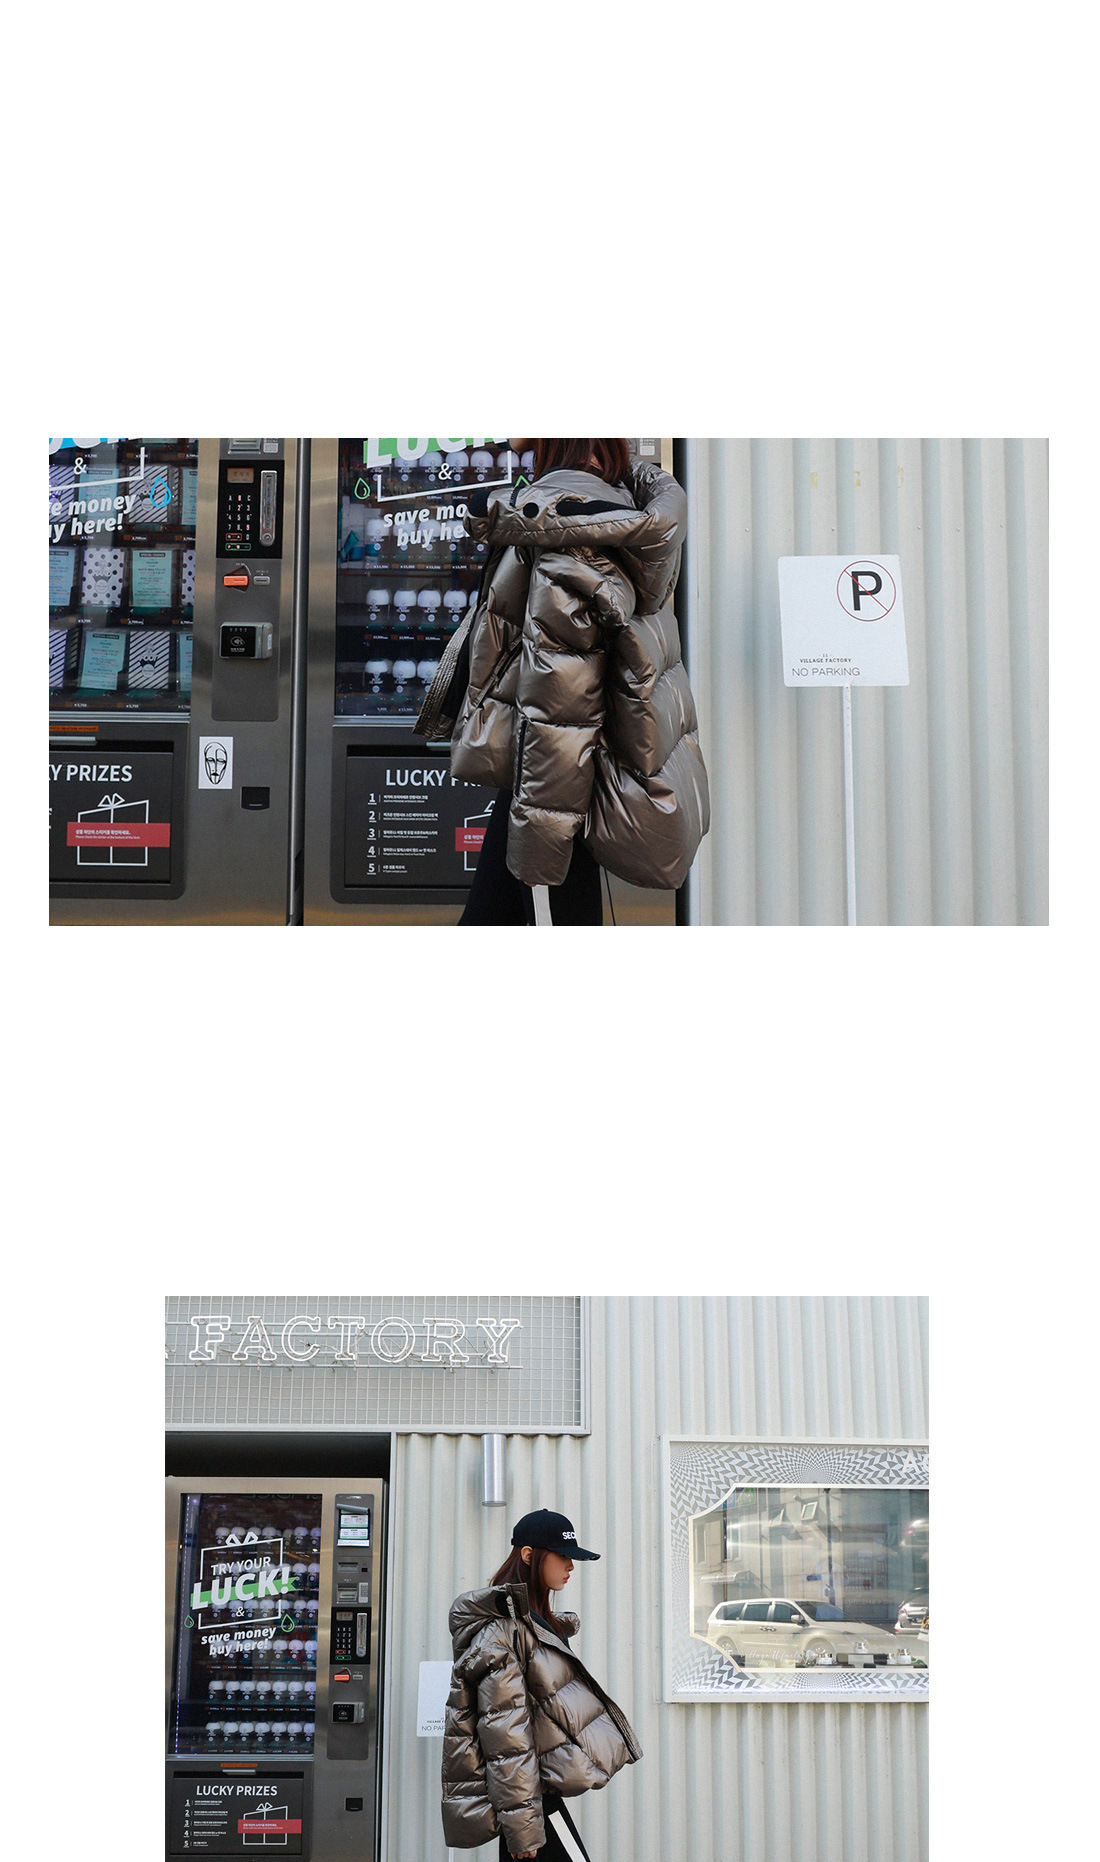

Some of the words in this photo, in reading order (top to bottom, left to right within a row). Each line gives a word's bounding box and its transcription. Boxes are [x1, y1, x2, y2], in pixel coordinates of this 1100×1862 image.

[74, 457, 87, 475] &
[438, 462, 452, 480] &
[68, 493, 137, 516] money
[71, 513, 124, 536] here!
[383, 508, 430, 527] save
[397, 527, 434, 548] buy
[792, 668, 808, 677] NO
[812, 667, 861, 676] PARKING
[49, 764, 62, 782] Y
[66, 764, 133, 782] PRIZES
[385, 769, 446, 787] LUCKY
[369, 793, 375, 802] 1
[369, 811, 375, 820] 2
[369, 828, 375, 837] 3
[368, 846, 375, 855] 4
[368, 863, 375, 872] 5
[189, 1315, 520, 1362] FACTORY
[210, 1562, 235, 1576] TRY
[236, 1556, 271, 1573] YOUR
[192, 1567, 290, 1610] LUCK!
[235, 1606, 245, 1617] &
[201, 1632, 230, 1645] save
[233, 1627, 277, 1640] money
[209, 1644, 232, 1657] buy
[235, 1639, 269, 1652] here!
[196, 1785, 234, 1796] LUCKY
[236, 1785, 278, 1796] PRIZES
